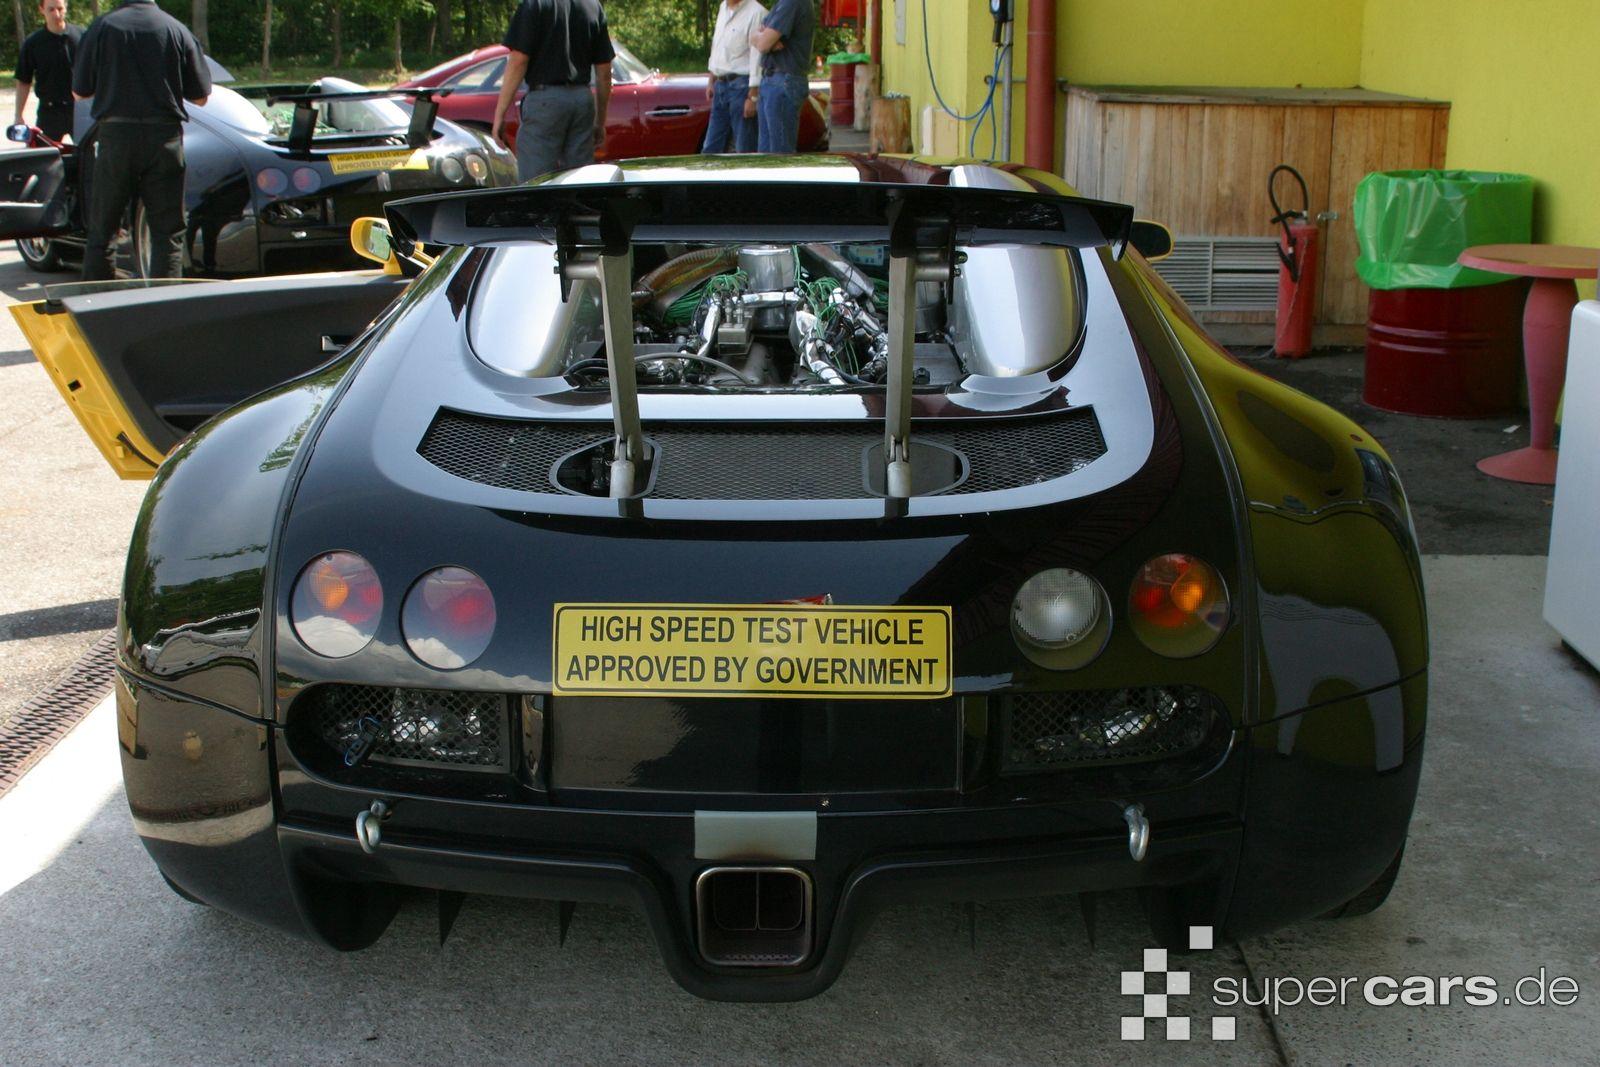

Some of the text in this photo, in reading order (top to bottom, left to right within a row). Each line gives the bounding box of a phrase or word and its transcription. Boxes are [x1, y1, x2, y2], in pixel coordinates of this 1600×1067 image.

[581, 615, 924, 645] HIGH SPEED TEST VEHICLE
[566, 655, 939, 685] APPROVED BY GOVERNMENT
